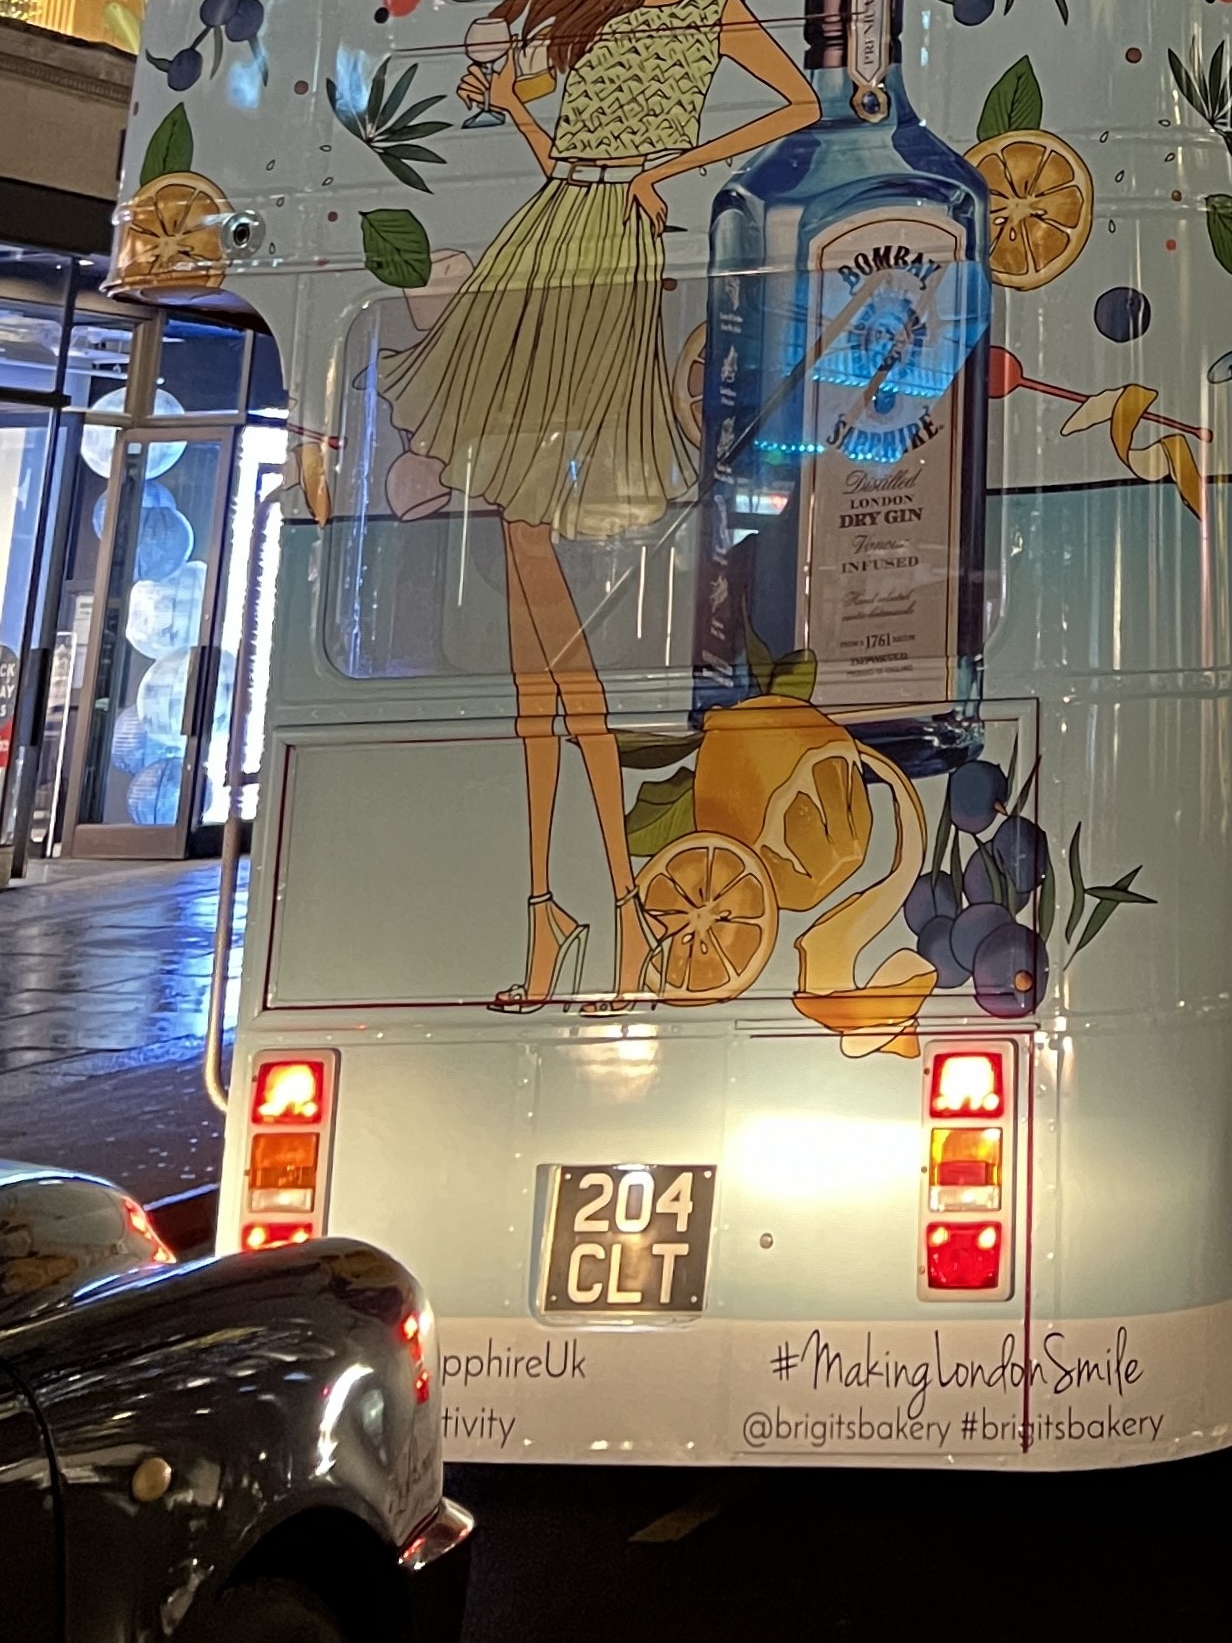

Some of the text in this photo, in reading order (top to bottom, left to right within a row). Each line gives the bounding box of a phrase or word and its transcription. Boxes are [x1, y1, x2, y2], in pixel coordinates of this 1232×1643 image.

[838, 244, 942, 296] BOMBAY
[842, 468, 923, 495] Distilled
[839, 507, 924, 529] DRY GIN
[850, 494, 915, 510] LONDON
[841, 556, 919, 574] INFUSED
[865, 633, 891, 650] 1761
[574, 1171, 694, 1233] 204
[567, 1243, 690, 1304] CLT
[441, 1337, 587, 1386] pphireUk
[441, 1404, 1165, 1449] tivity @brigitsbakery #brigitsbakery
